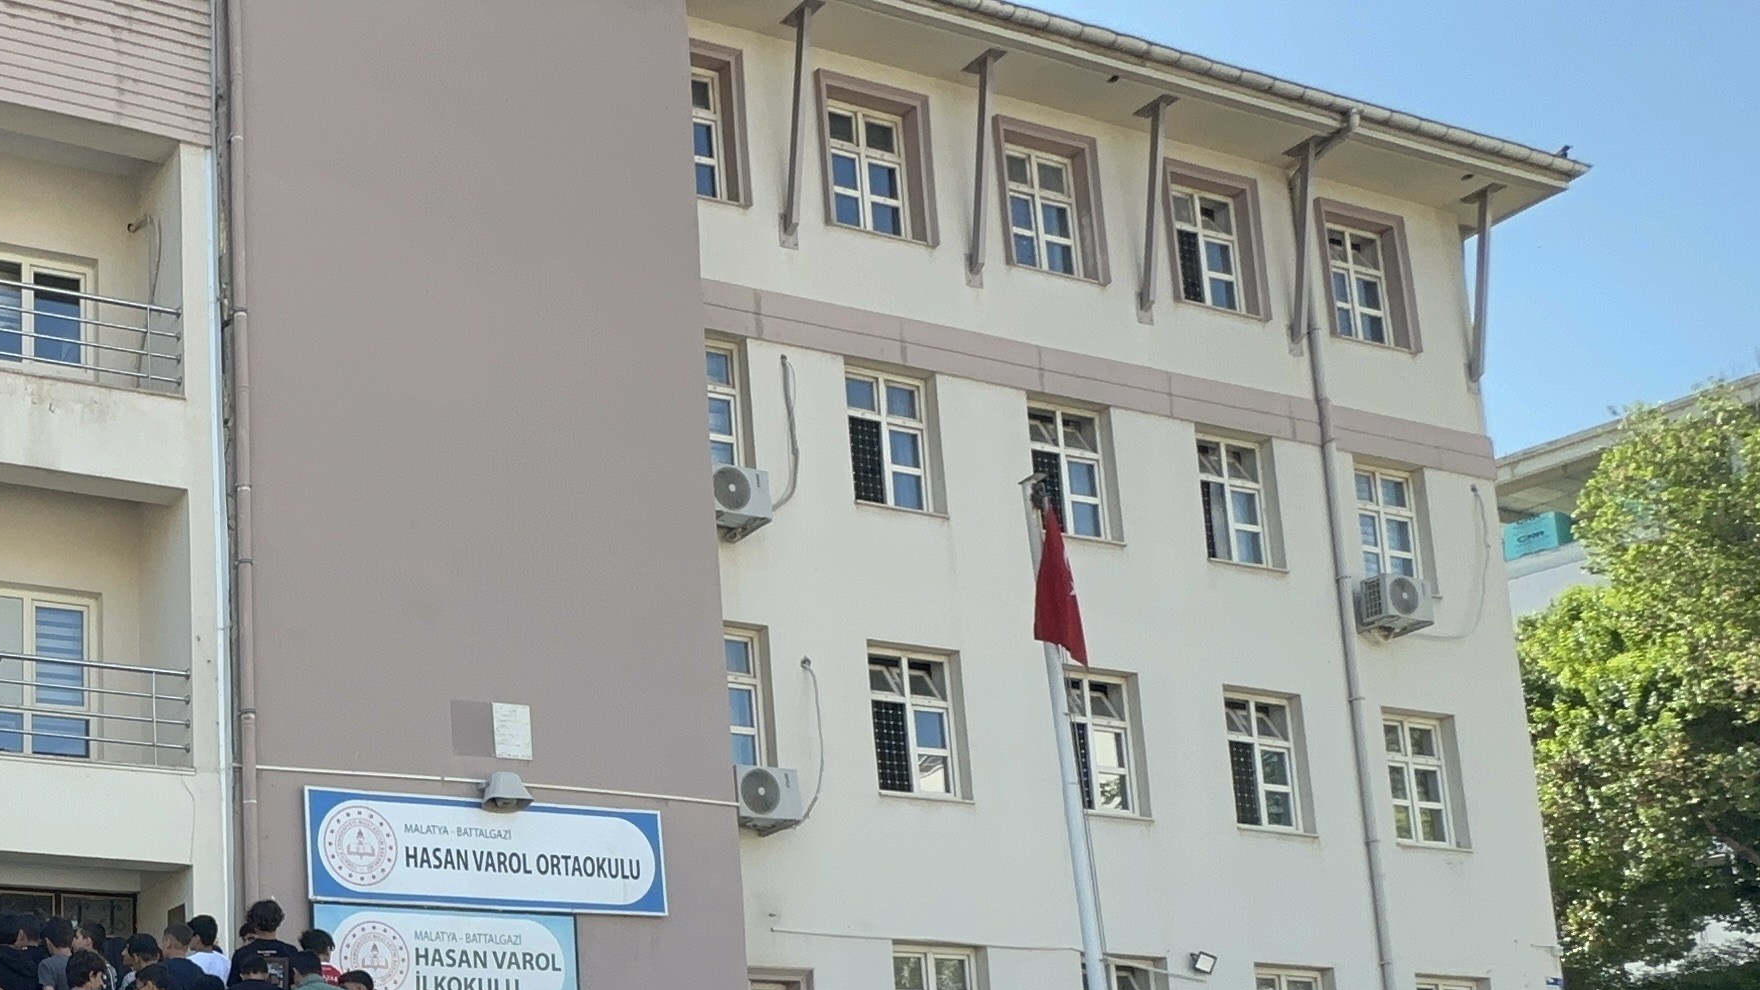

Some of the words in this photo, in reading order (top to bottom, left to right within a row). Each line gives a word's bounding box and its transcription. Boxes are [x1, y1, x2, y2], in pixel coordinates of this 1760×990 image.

[403, 823, 450, 838] MALATYA
[456, 826, 512, 841] BATTALGAZİ
[404, 846, 470, 872] HASAN
[472, 851, 533, 876] VAROL
[536, 854, 641, 881] ORTAOKULU
[414, 930, 458, 943] MALATYA
[465, 932, 522, 946] BATTALGAZİ
[415, 947, 488, 970] HASAN
[493, 951, 562, 973] VAROL
